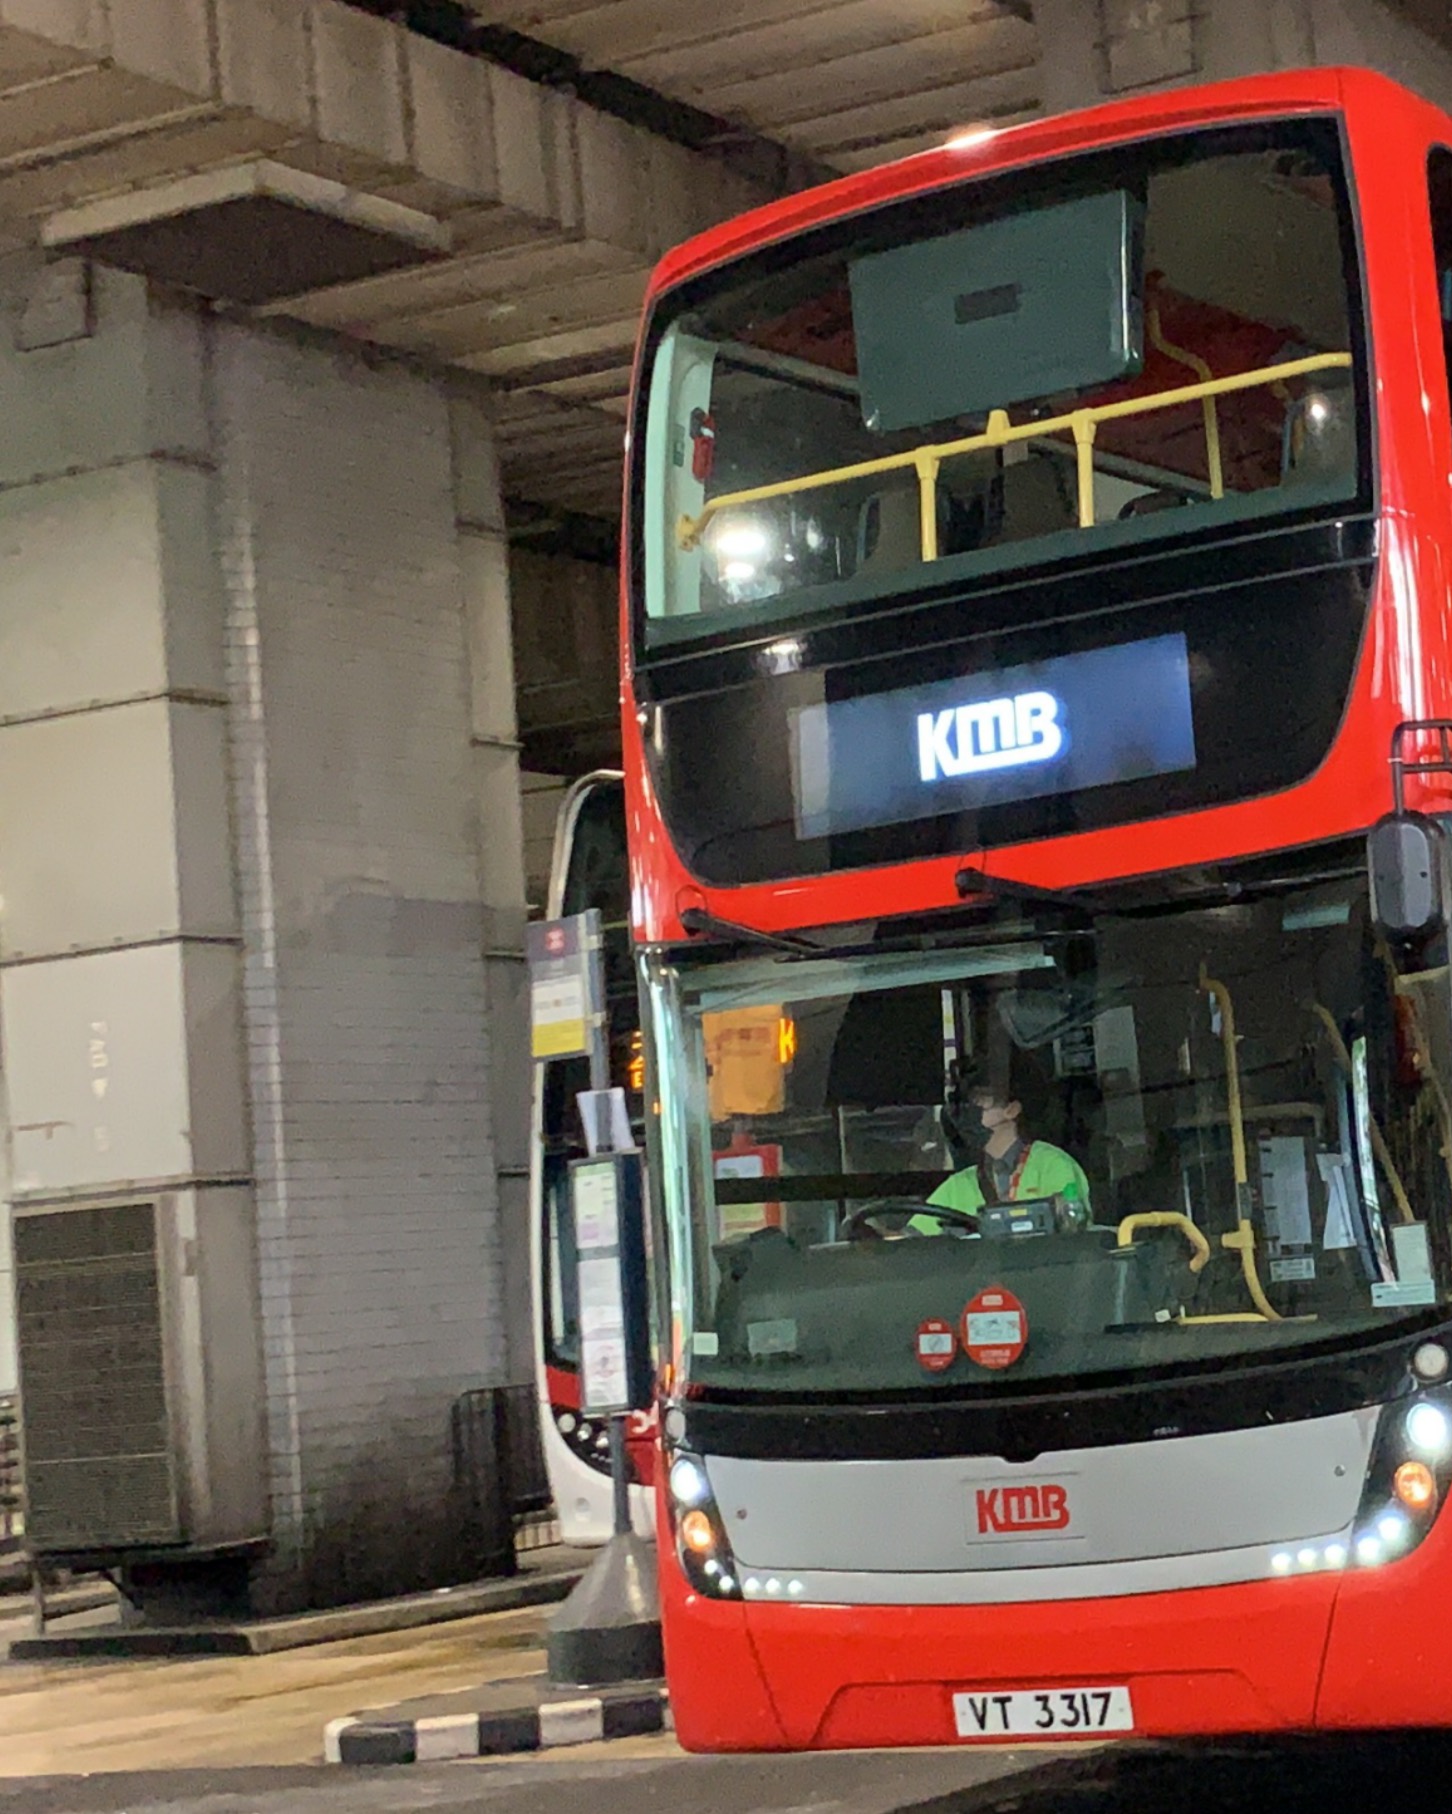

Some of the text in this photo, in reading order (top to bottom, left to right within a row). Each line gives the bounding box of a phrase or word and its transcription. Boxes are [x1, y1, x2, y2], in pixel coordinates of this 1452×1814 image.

[917, 691, 1062, 781] KMB
[976, 1485, 1070, 1533] KMB
[968, 1692, 1112, 1731] VT 3317
